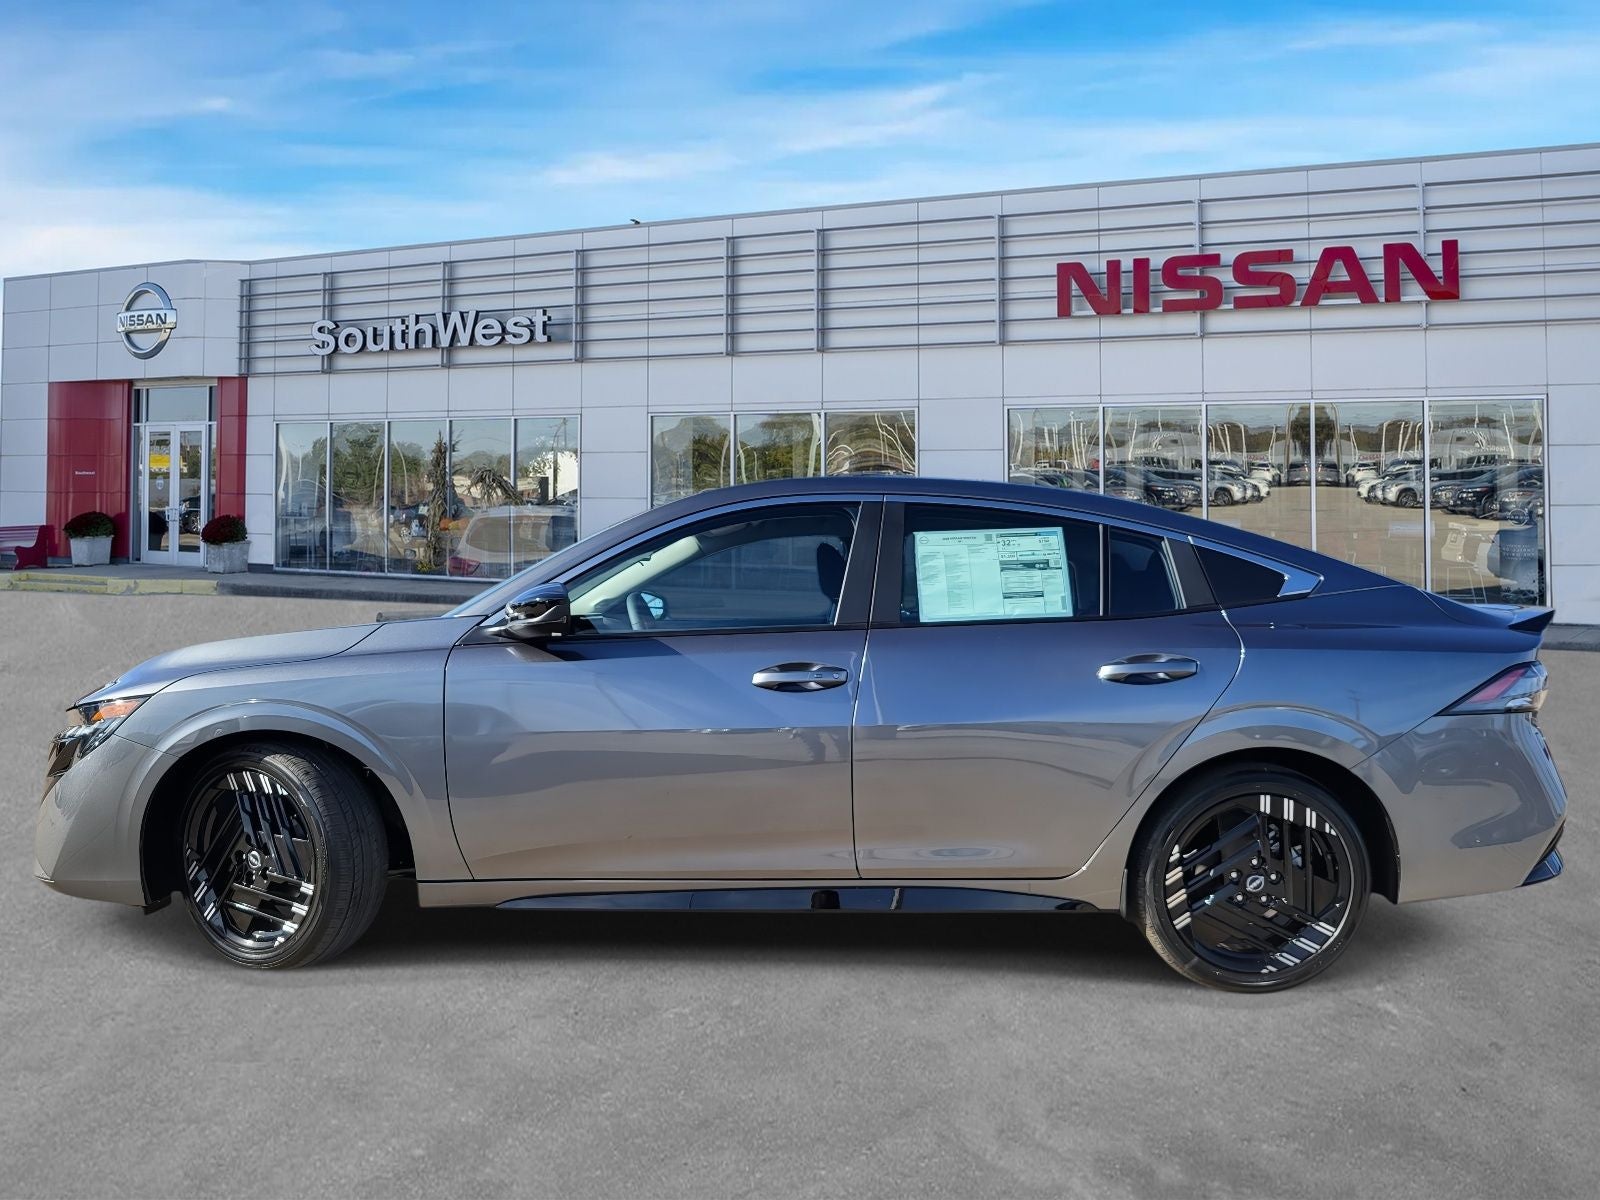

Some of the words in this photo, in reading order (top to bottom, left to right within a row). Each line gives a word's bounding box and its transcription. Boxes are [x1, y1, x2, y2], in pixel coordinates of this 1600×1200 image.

[1057, 239, 1461, 318] NISSAN
[118, 312, 167, 328] NISSAN
[310, 308, 550, 356] SouthWest
